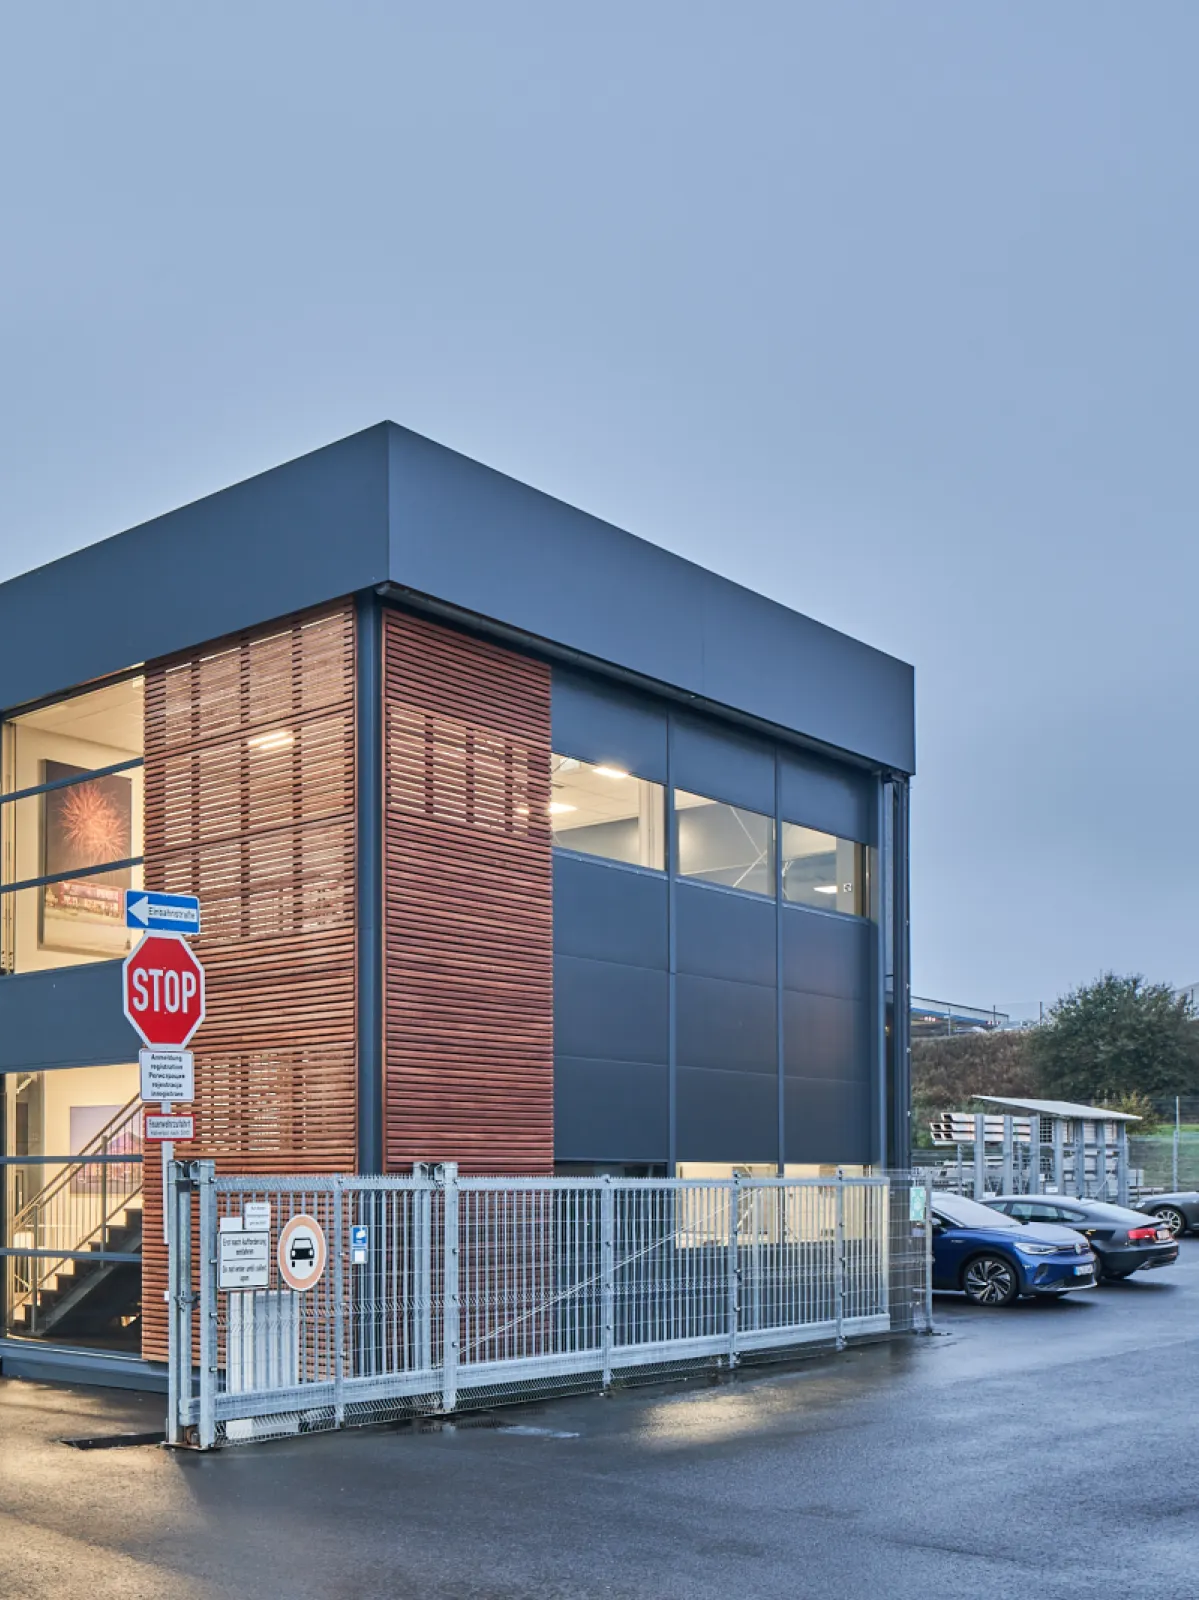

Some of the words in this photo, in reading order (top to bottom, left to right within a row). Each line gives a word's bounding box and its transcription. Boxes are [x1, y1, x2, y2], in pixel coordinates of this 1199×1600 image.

[132, 967, 197, 1014] STOP
[150, 1053, 182, 1062] Anmeldung
[150, 1063, 183, 1071] registration
